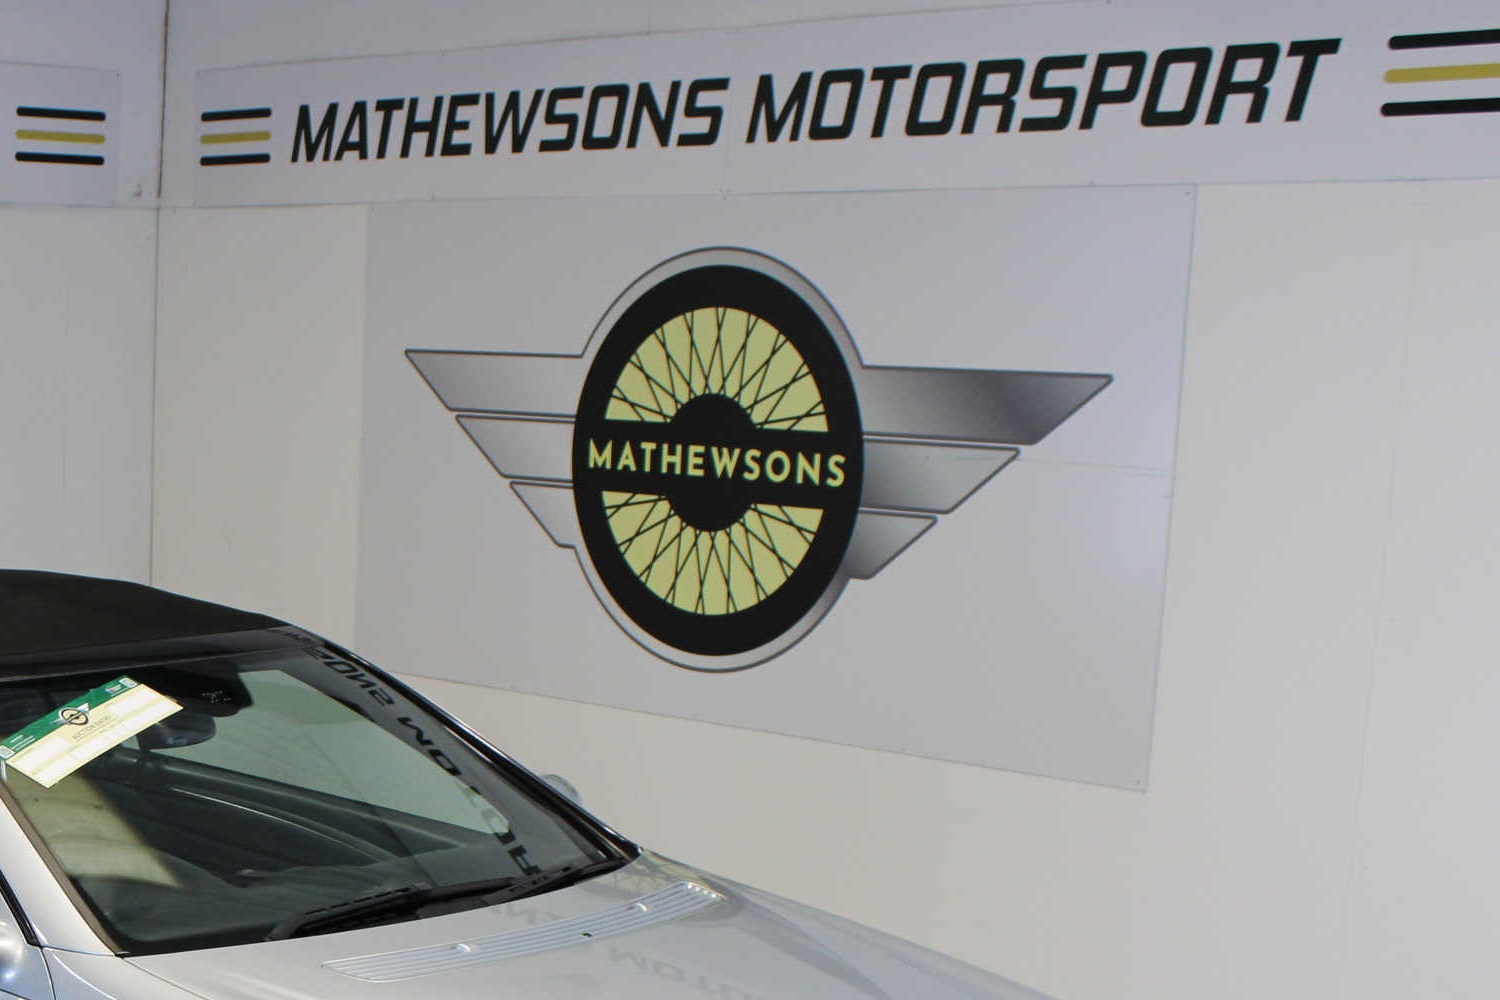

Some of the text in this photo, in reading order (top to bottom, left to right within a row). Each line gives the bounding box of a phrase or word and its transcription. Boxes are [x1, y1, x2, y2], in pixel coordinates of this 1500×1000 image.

[290, 37, 1342, 163] MATHEWSONS MOTORSPORT
[587, 437, 847, 488] MATHEWSONS
[72, 725, 96, 740] AUCTION
[94, 714, 113, 726] ENTRY
